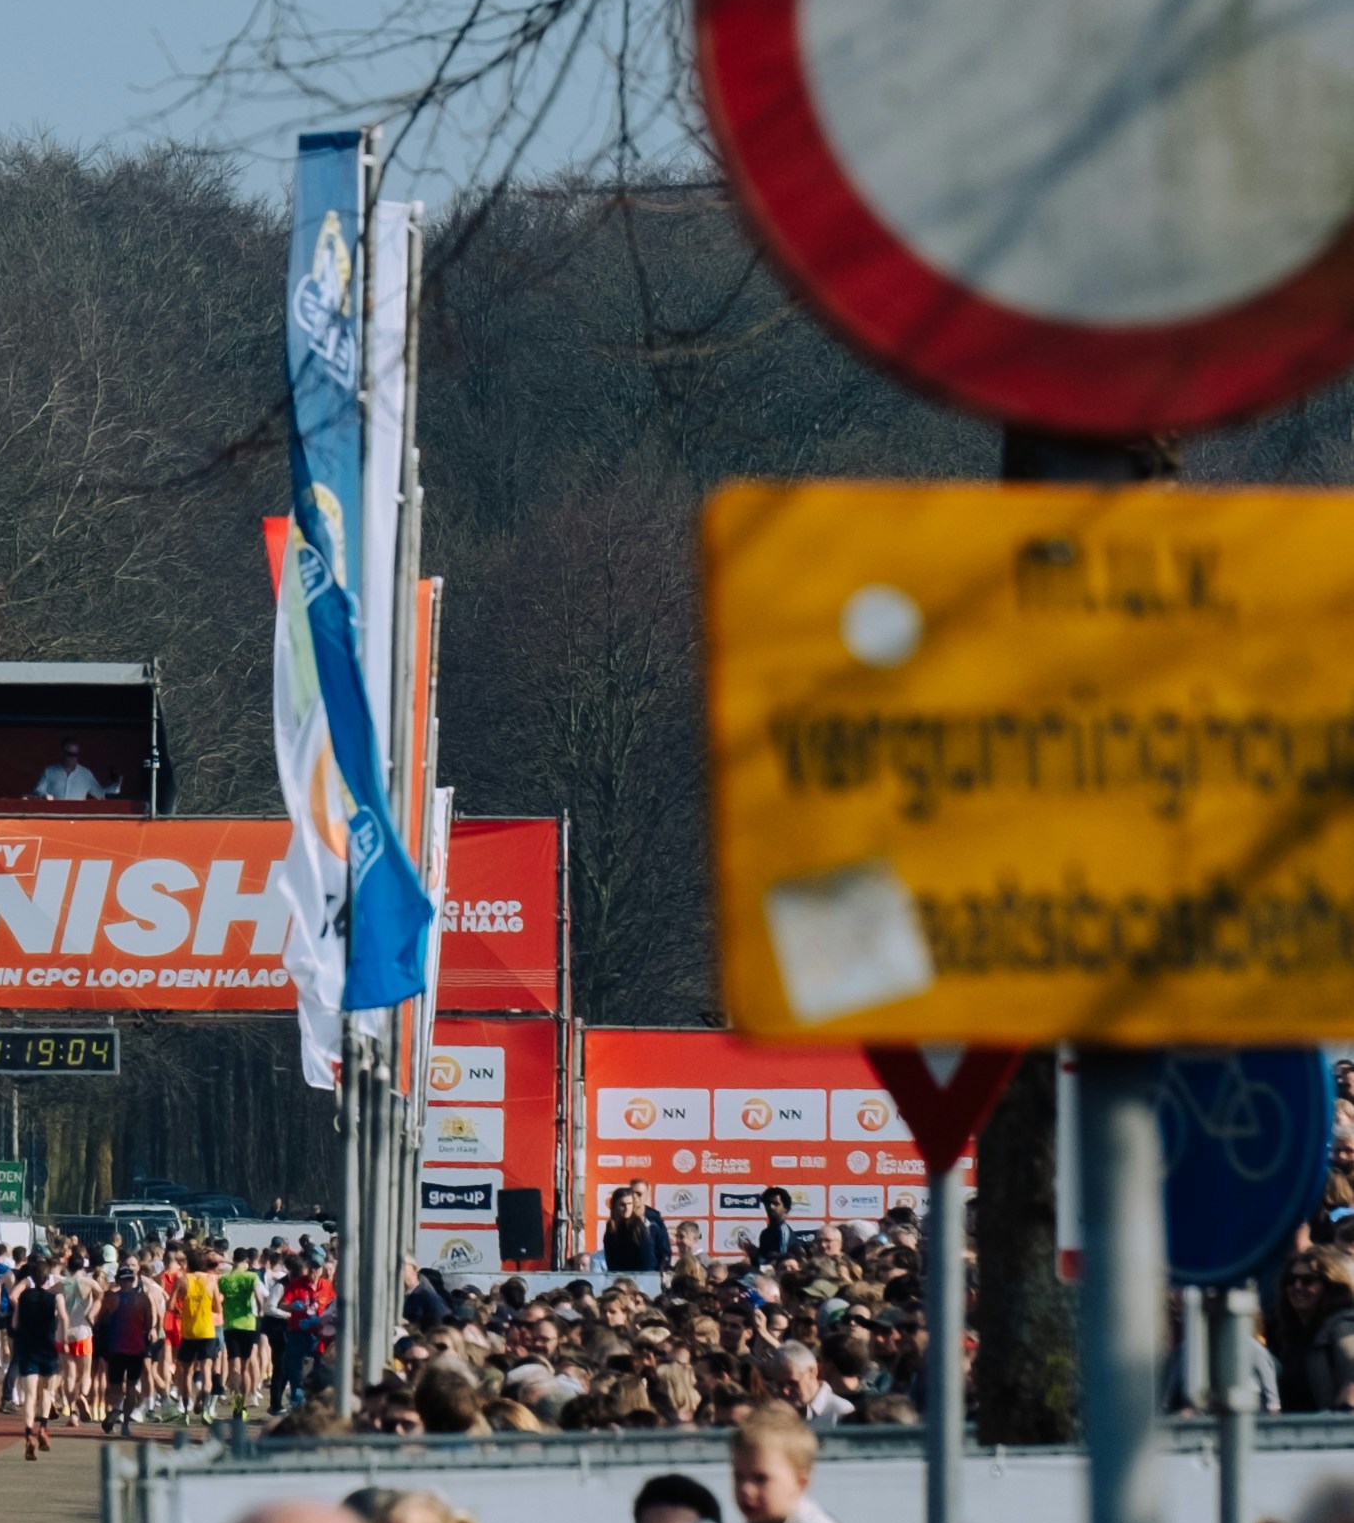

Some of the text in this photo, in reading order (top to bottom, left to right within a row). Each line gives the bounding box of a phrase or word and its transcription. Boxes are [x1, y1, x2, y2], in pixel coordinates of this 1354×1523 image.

[463, 900, 522, 916] LOOP
[461, 916, 523, 932] HAAG
[26, 967, 81, 986] CPC
[85, 968, 155, 987] LOOP
[157, 969, 211, 987] DEN
[213, 968, 289, 987] HAAG
[469, 1068, 494, 1080] NN
[662, 1107, 686, 1120] NN
[779, 1109, 802, 1120] NN
[428, 1189, 485, 1207] gro-up
